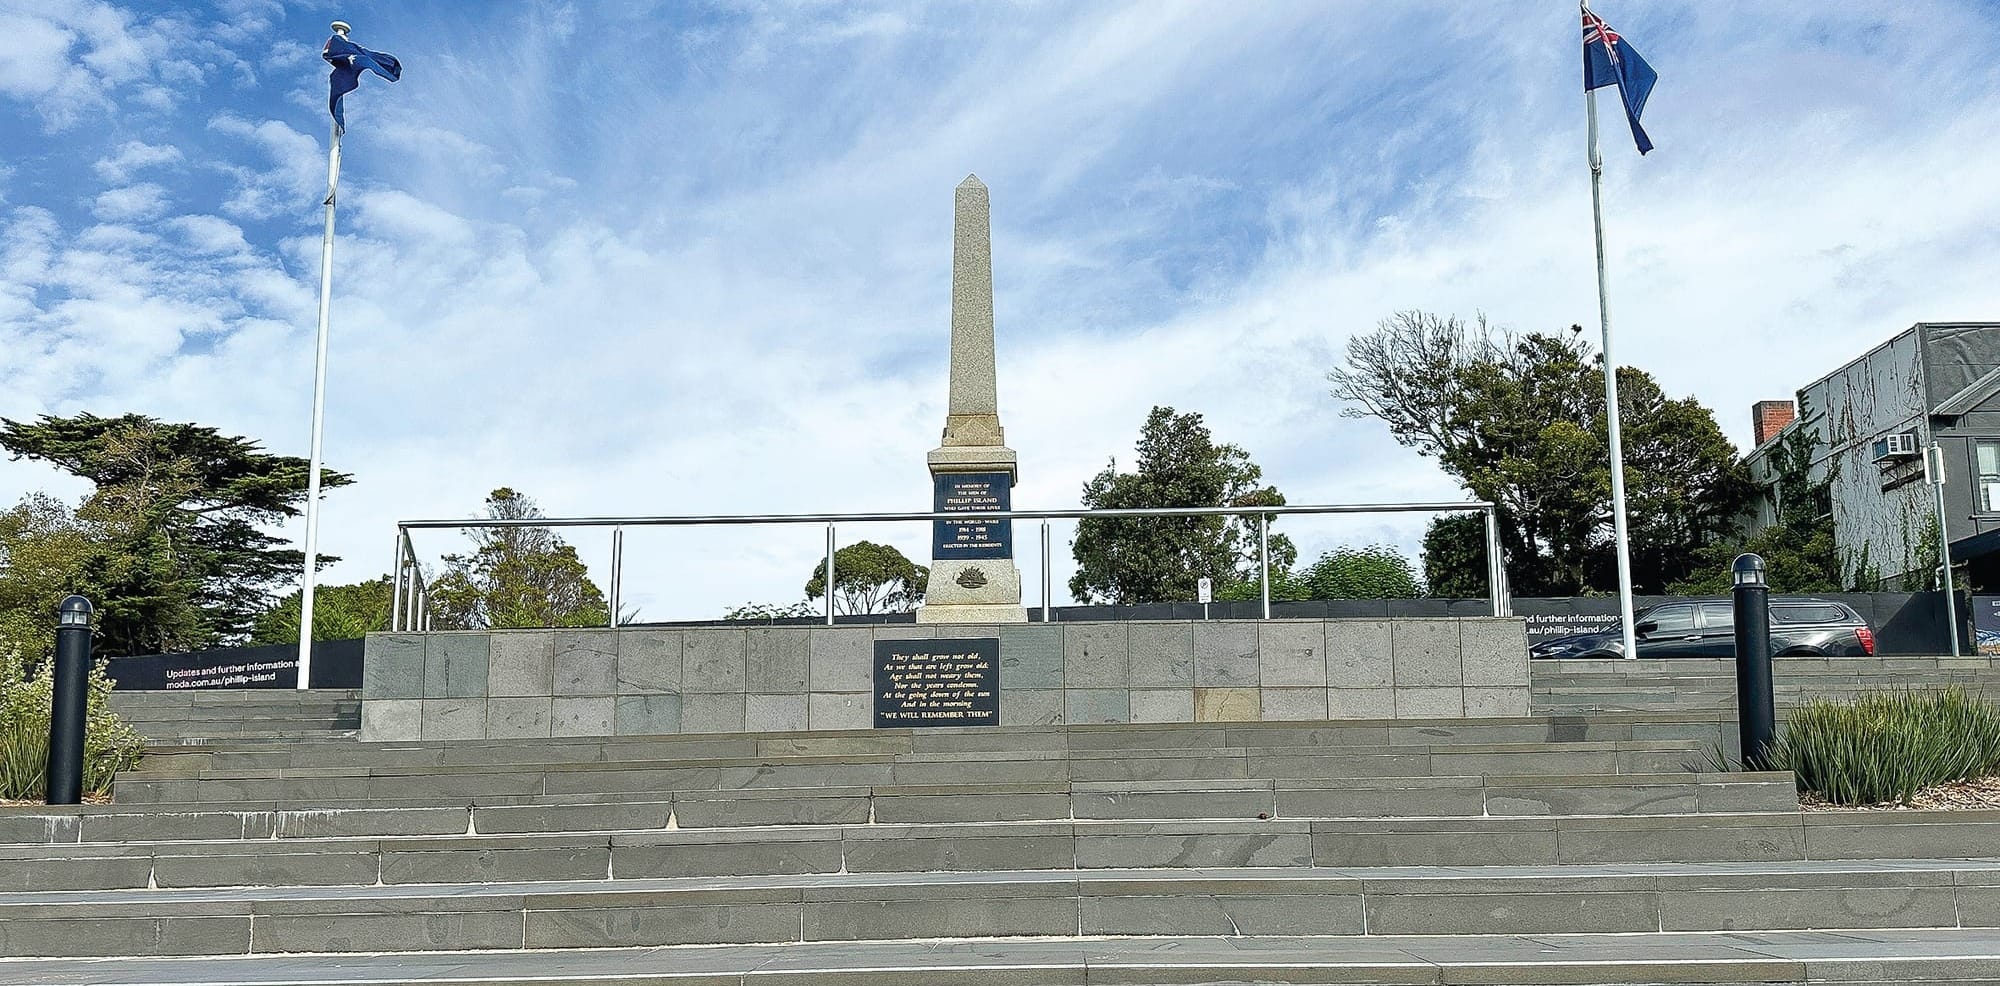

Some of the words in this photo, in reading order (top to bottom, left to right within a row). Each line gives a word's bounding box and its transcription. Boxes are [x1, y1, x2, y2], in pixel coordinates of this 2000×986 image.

[1536, 614, 1566, 622] further
[1568, 614, 1618, 622] information
[892, 654, 909, 662] They
[166, 669, 200, 679] Updates
[202, 666, 216, 676] and
[218, 665, 246, 674] further
[247, 660, 294, 672] information
[940, 663, 952, 671] left
[166, 672, 275, 689] moda.com.au/phillip-island
